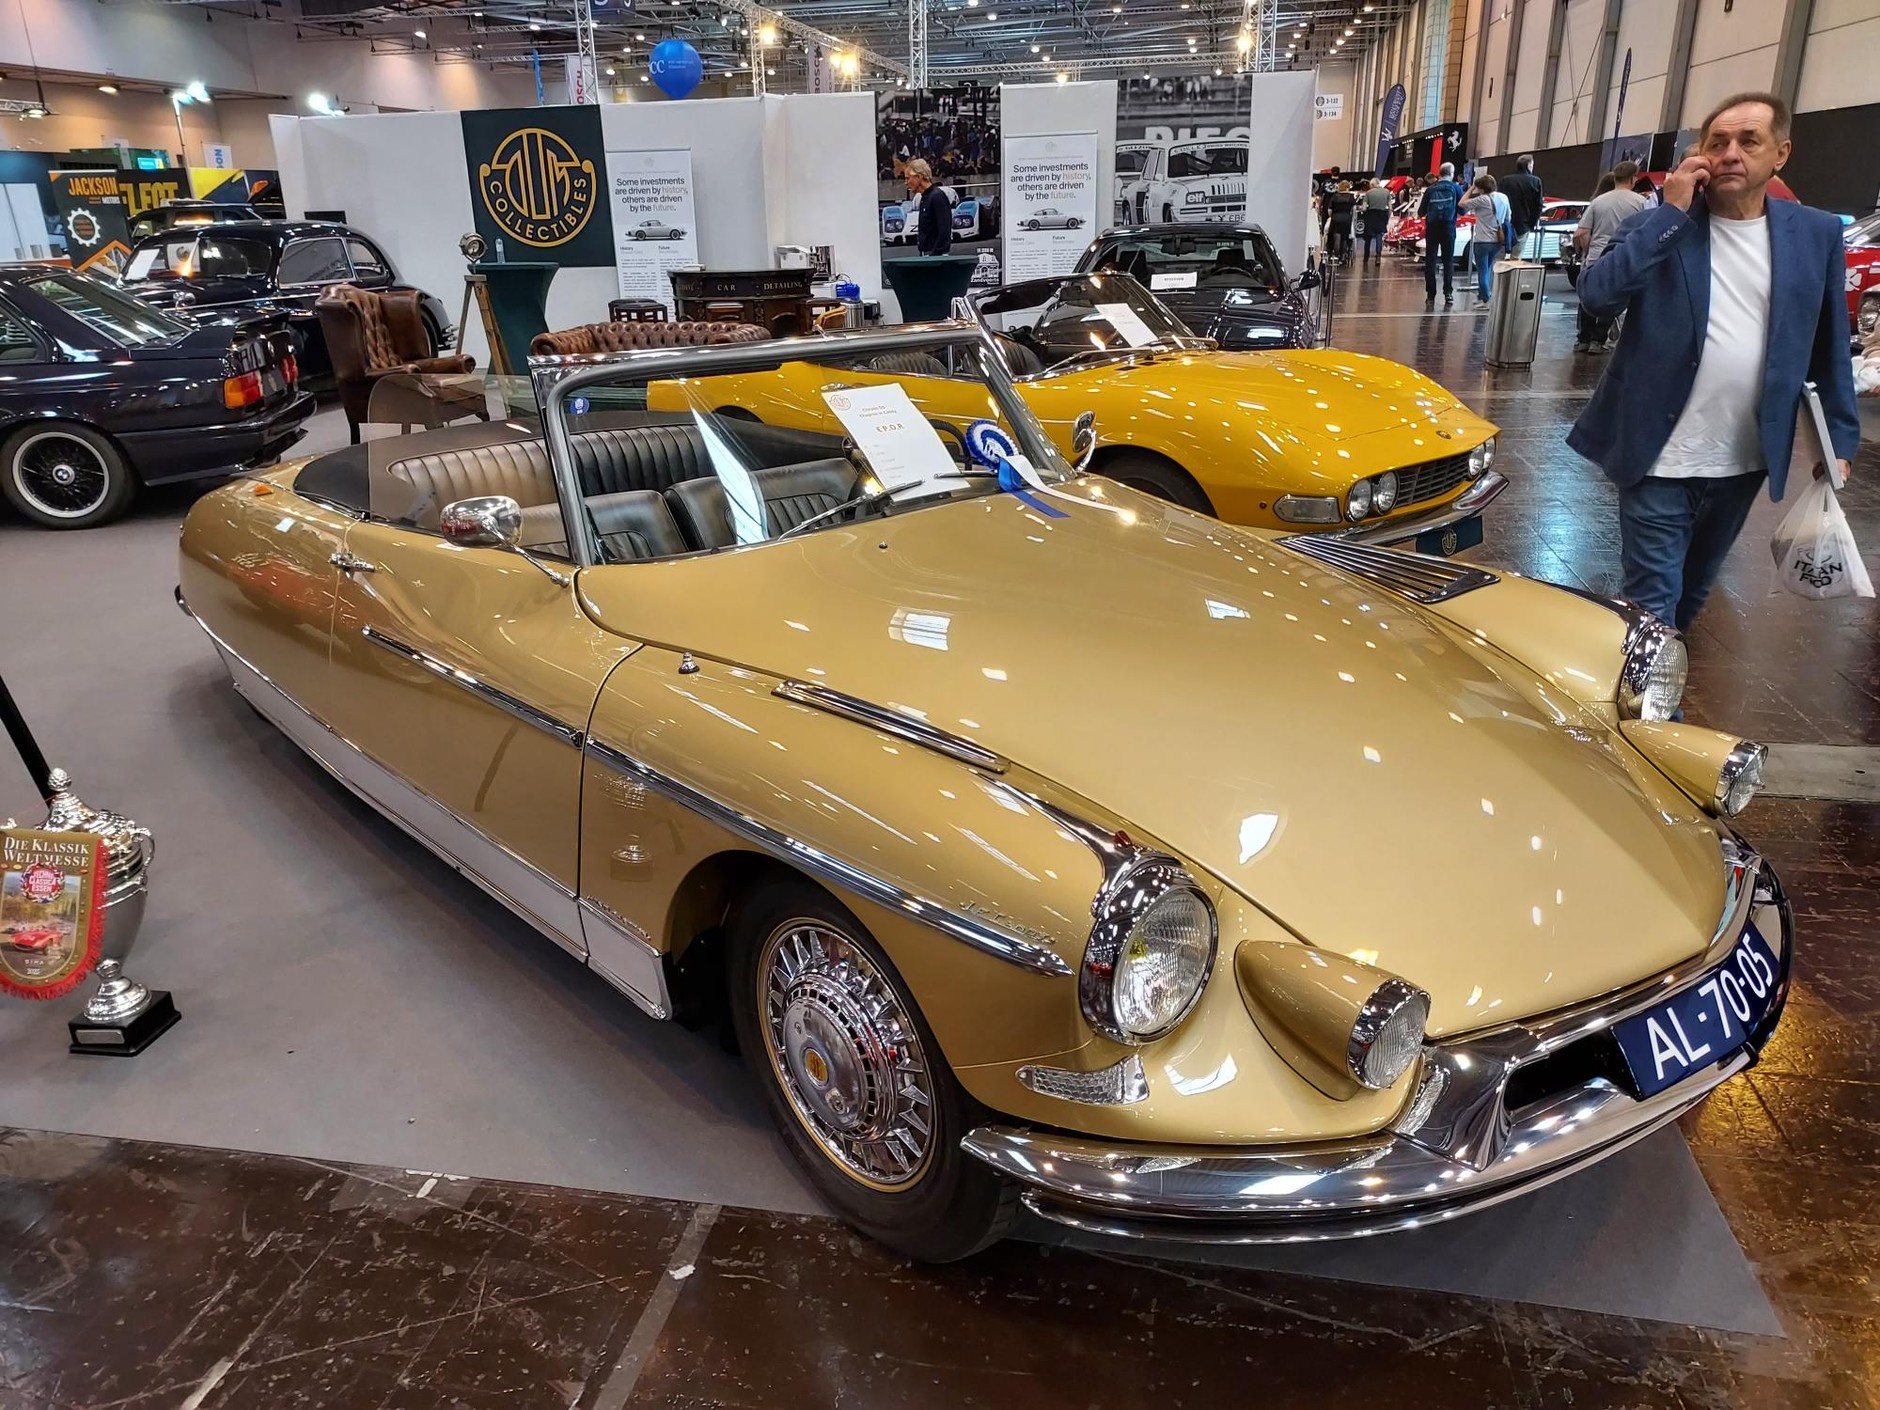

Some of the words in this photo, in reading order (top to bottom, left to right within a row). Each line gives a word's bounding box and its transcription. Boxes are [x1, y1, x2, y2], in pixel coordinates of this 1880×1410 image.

[1013, 164, 1038, 173] Some
[1039, 162, 1089, 172] investments
[616, 178, 639, 187] Some
[640, 177, 685, 186] investments
[1025, 173, 1050, 182] driven
[1051, 172, 1062, 182] by
[1062, 172, 1091, 181] history,
[68, 177, 119, 196] JACKSON
[628, 186, 651, 195] driven
[651, 186, 661, 196] by
[662, 186, 688, 195] history,
[1017, 183, 1043, 191] others
[1059, 181, 1084, 190] driven
[621, 195, 646, 204] others
[659, 195, 683, 203] driven
[1025, 192, 1035, 201] by
[1036, 191, 1050, 200] the
[1050, 190, 1076, 199] future.
[490, 178, 587, 241] COLLECTIBLES
[629, 204, 639, 213] by
[640, 204, 652, 212] the
[652, 204, 676, 212] future.
[763, 281, 803, 290] DETAILING
[5, 837, 30, 850] DIE
[32, 838, 90, 855] KLASSIK
